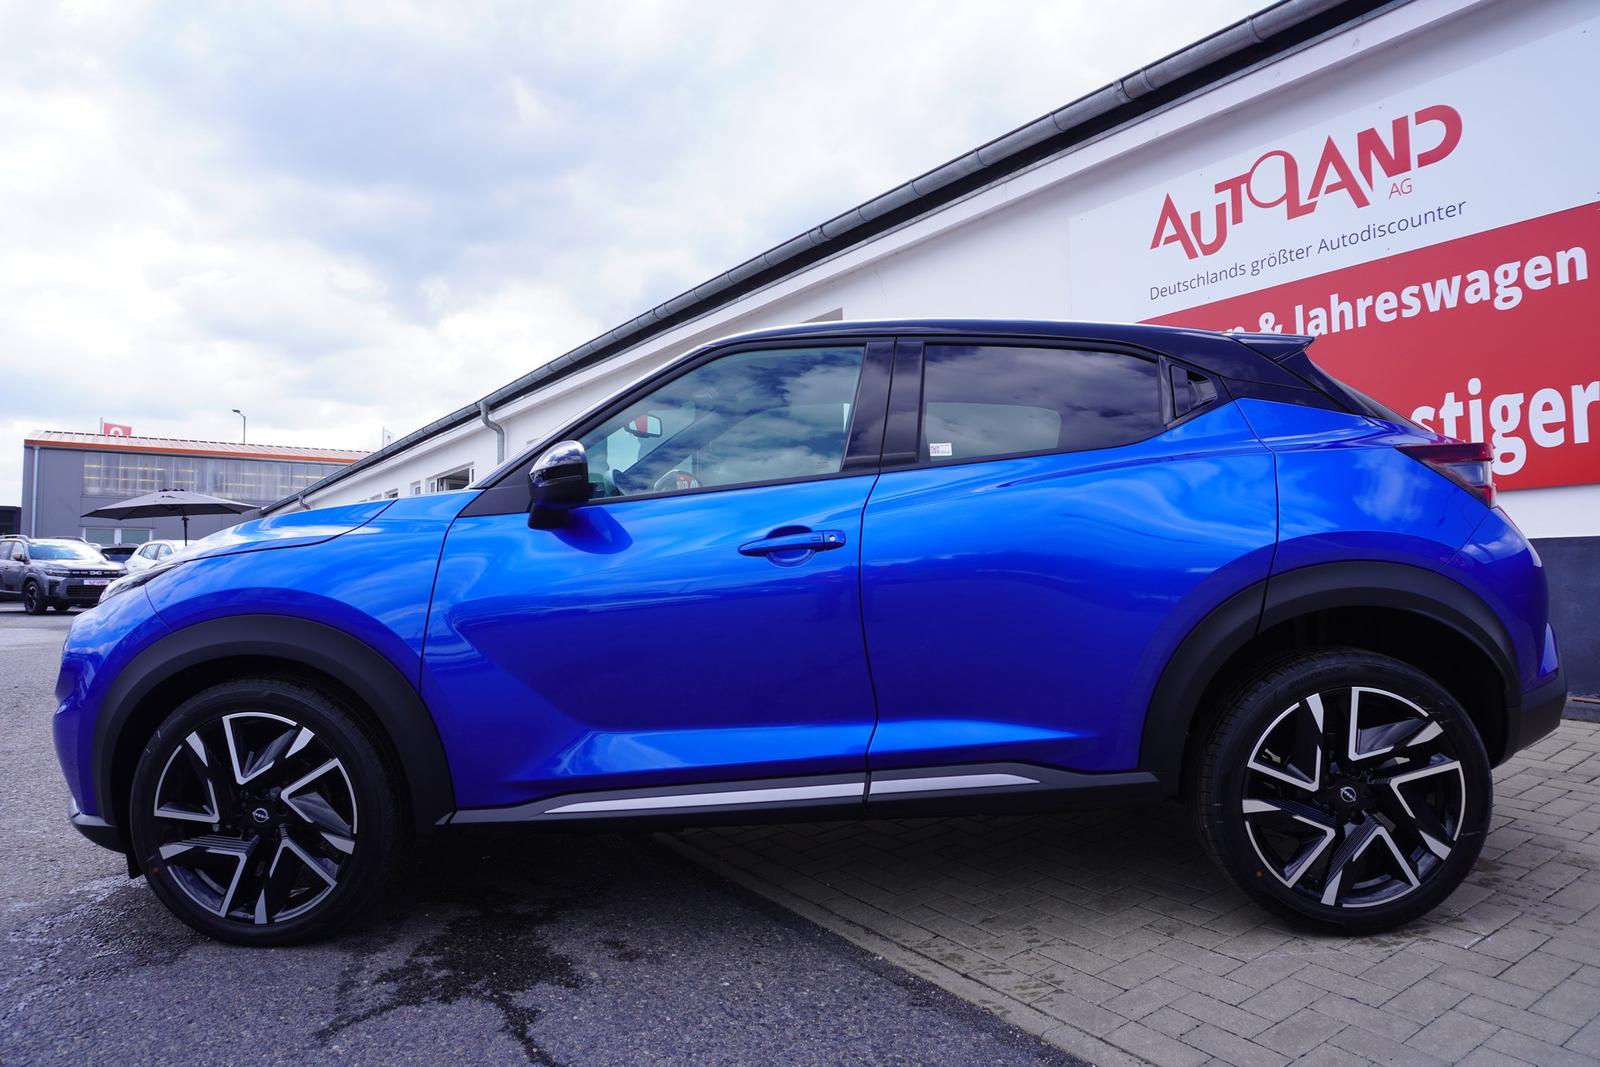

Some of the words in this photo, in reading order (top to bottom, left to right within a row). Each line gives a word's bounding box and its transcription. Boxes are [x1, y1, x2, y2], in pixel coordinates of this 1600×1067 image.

[1150, 104, 1463, 260] AUTOLAND
[1388, 177, 1413, 200] AG
[1150, 262, 1247, 301] Deutschlands
[1250, 244, 1313, 277] größter
[1317, 200, 1467, 255] Autodiscounter
